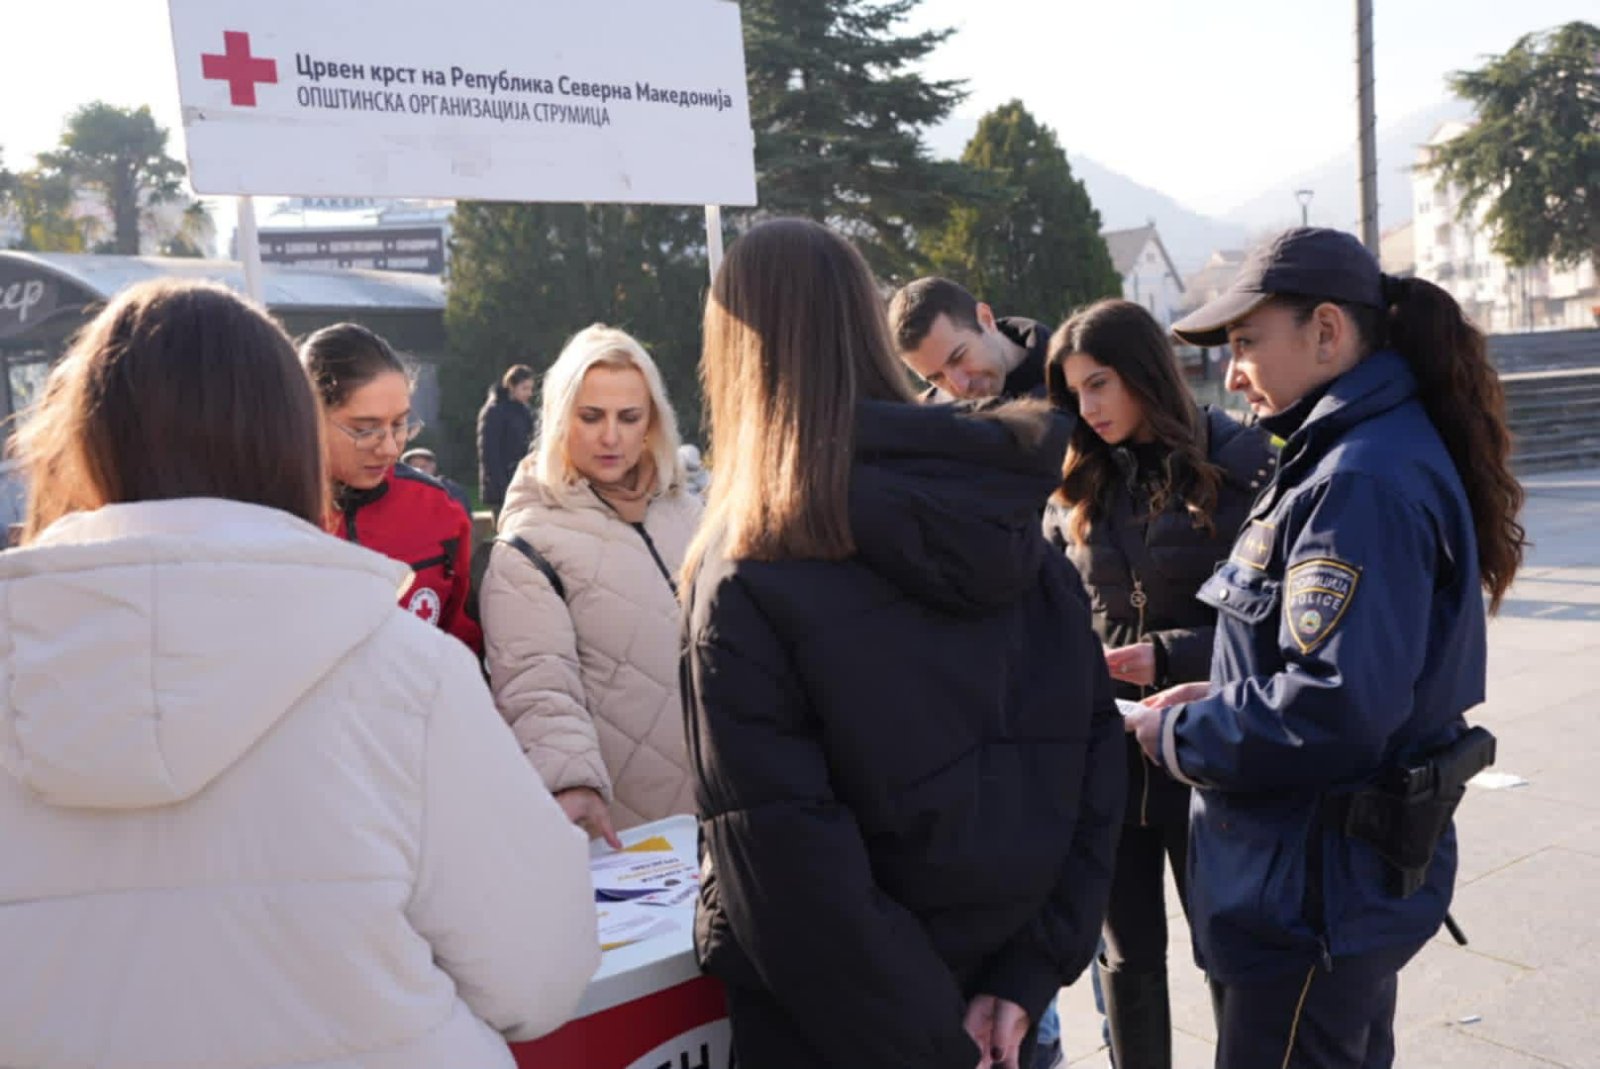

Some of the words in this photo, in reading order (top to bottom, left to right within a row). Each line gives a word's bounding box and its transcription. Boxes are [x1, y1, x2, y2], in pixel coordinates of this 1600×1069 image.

[296, 52, 365, 82] Црвен
[370, 64, 417, 87] крст
[421, 69, 447, 87] на
[450, 66, 554, 95] Република
[557, 75, 633, 103] Северна
[635, 81, 733, 112] Македонија
[296, 85, 406, 112] ОПШТИНСКА
[408, 93, 531, 122] ОРГАНИЗАЦИЈА
[533, 102, 611, 127] СТРУМИЦА
